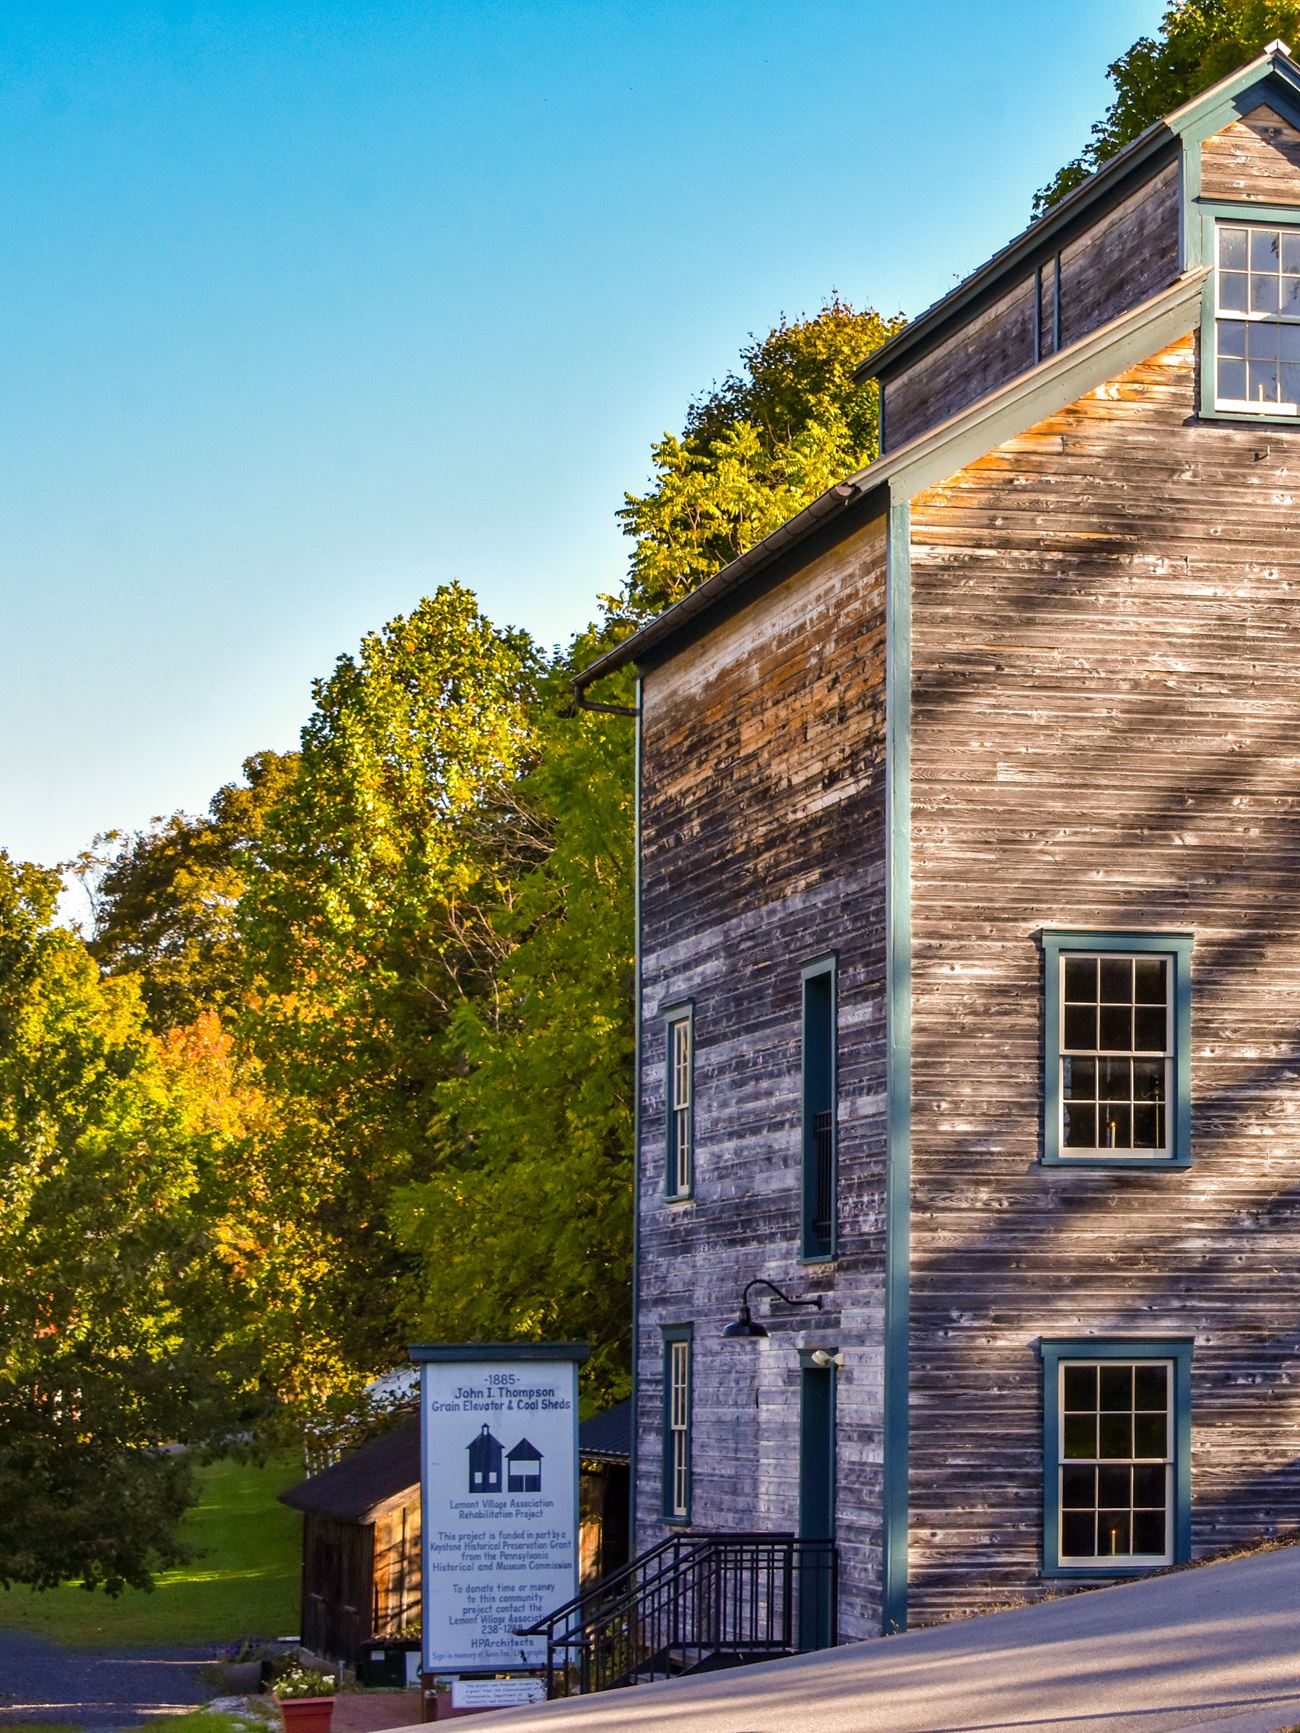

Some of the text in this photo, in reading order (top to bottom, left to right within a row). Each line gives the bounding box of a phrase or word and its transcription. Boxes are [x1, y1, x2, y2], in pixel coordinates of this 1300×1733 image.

[455, 1388, 483, 1399] John
[500, 1387, 554, 1399] Thompson
[432, 1399, 570, 1412] Grain Elevator & Coal Sheds
[450, 1500, 554, 1510] Lemont Village Association
[460, 1510, 543, 1520] Rehabilitation Project
[439, 1532, 455, 1540] This
[459, 1531, 485, 1542] project
[500, 1531, 524, 1539] funded
[536, 1531, 550, 1540] part
[552, 1530, 560, 1539] by
[431, 1543, 461, 1553] Keystone
[503, 1542, 548, 1550] Preservation
[550, 1541, 571, 1549] Grant
[462, 1552, 481, 1560] from
[500, 1552, 548, 1562] Pennsylvania
[433, 1561, 572, 1571] Historical and Museum Commission
[453, 1584, 462, 1593] To
[466, 1584, 493, 1592] donate
[498, 1584, 515, 1592] time
[530, 1584, 555, 1592] money
[480, 1595, 496, 1603] this
[499, 1594, 543, 1604] community
[463, 1604, 542, 1617] project contact the
[450, 1613, 544, 1625] Lemont Village Associat
[472, 1638, 534, 1648] HPArchitects
